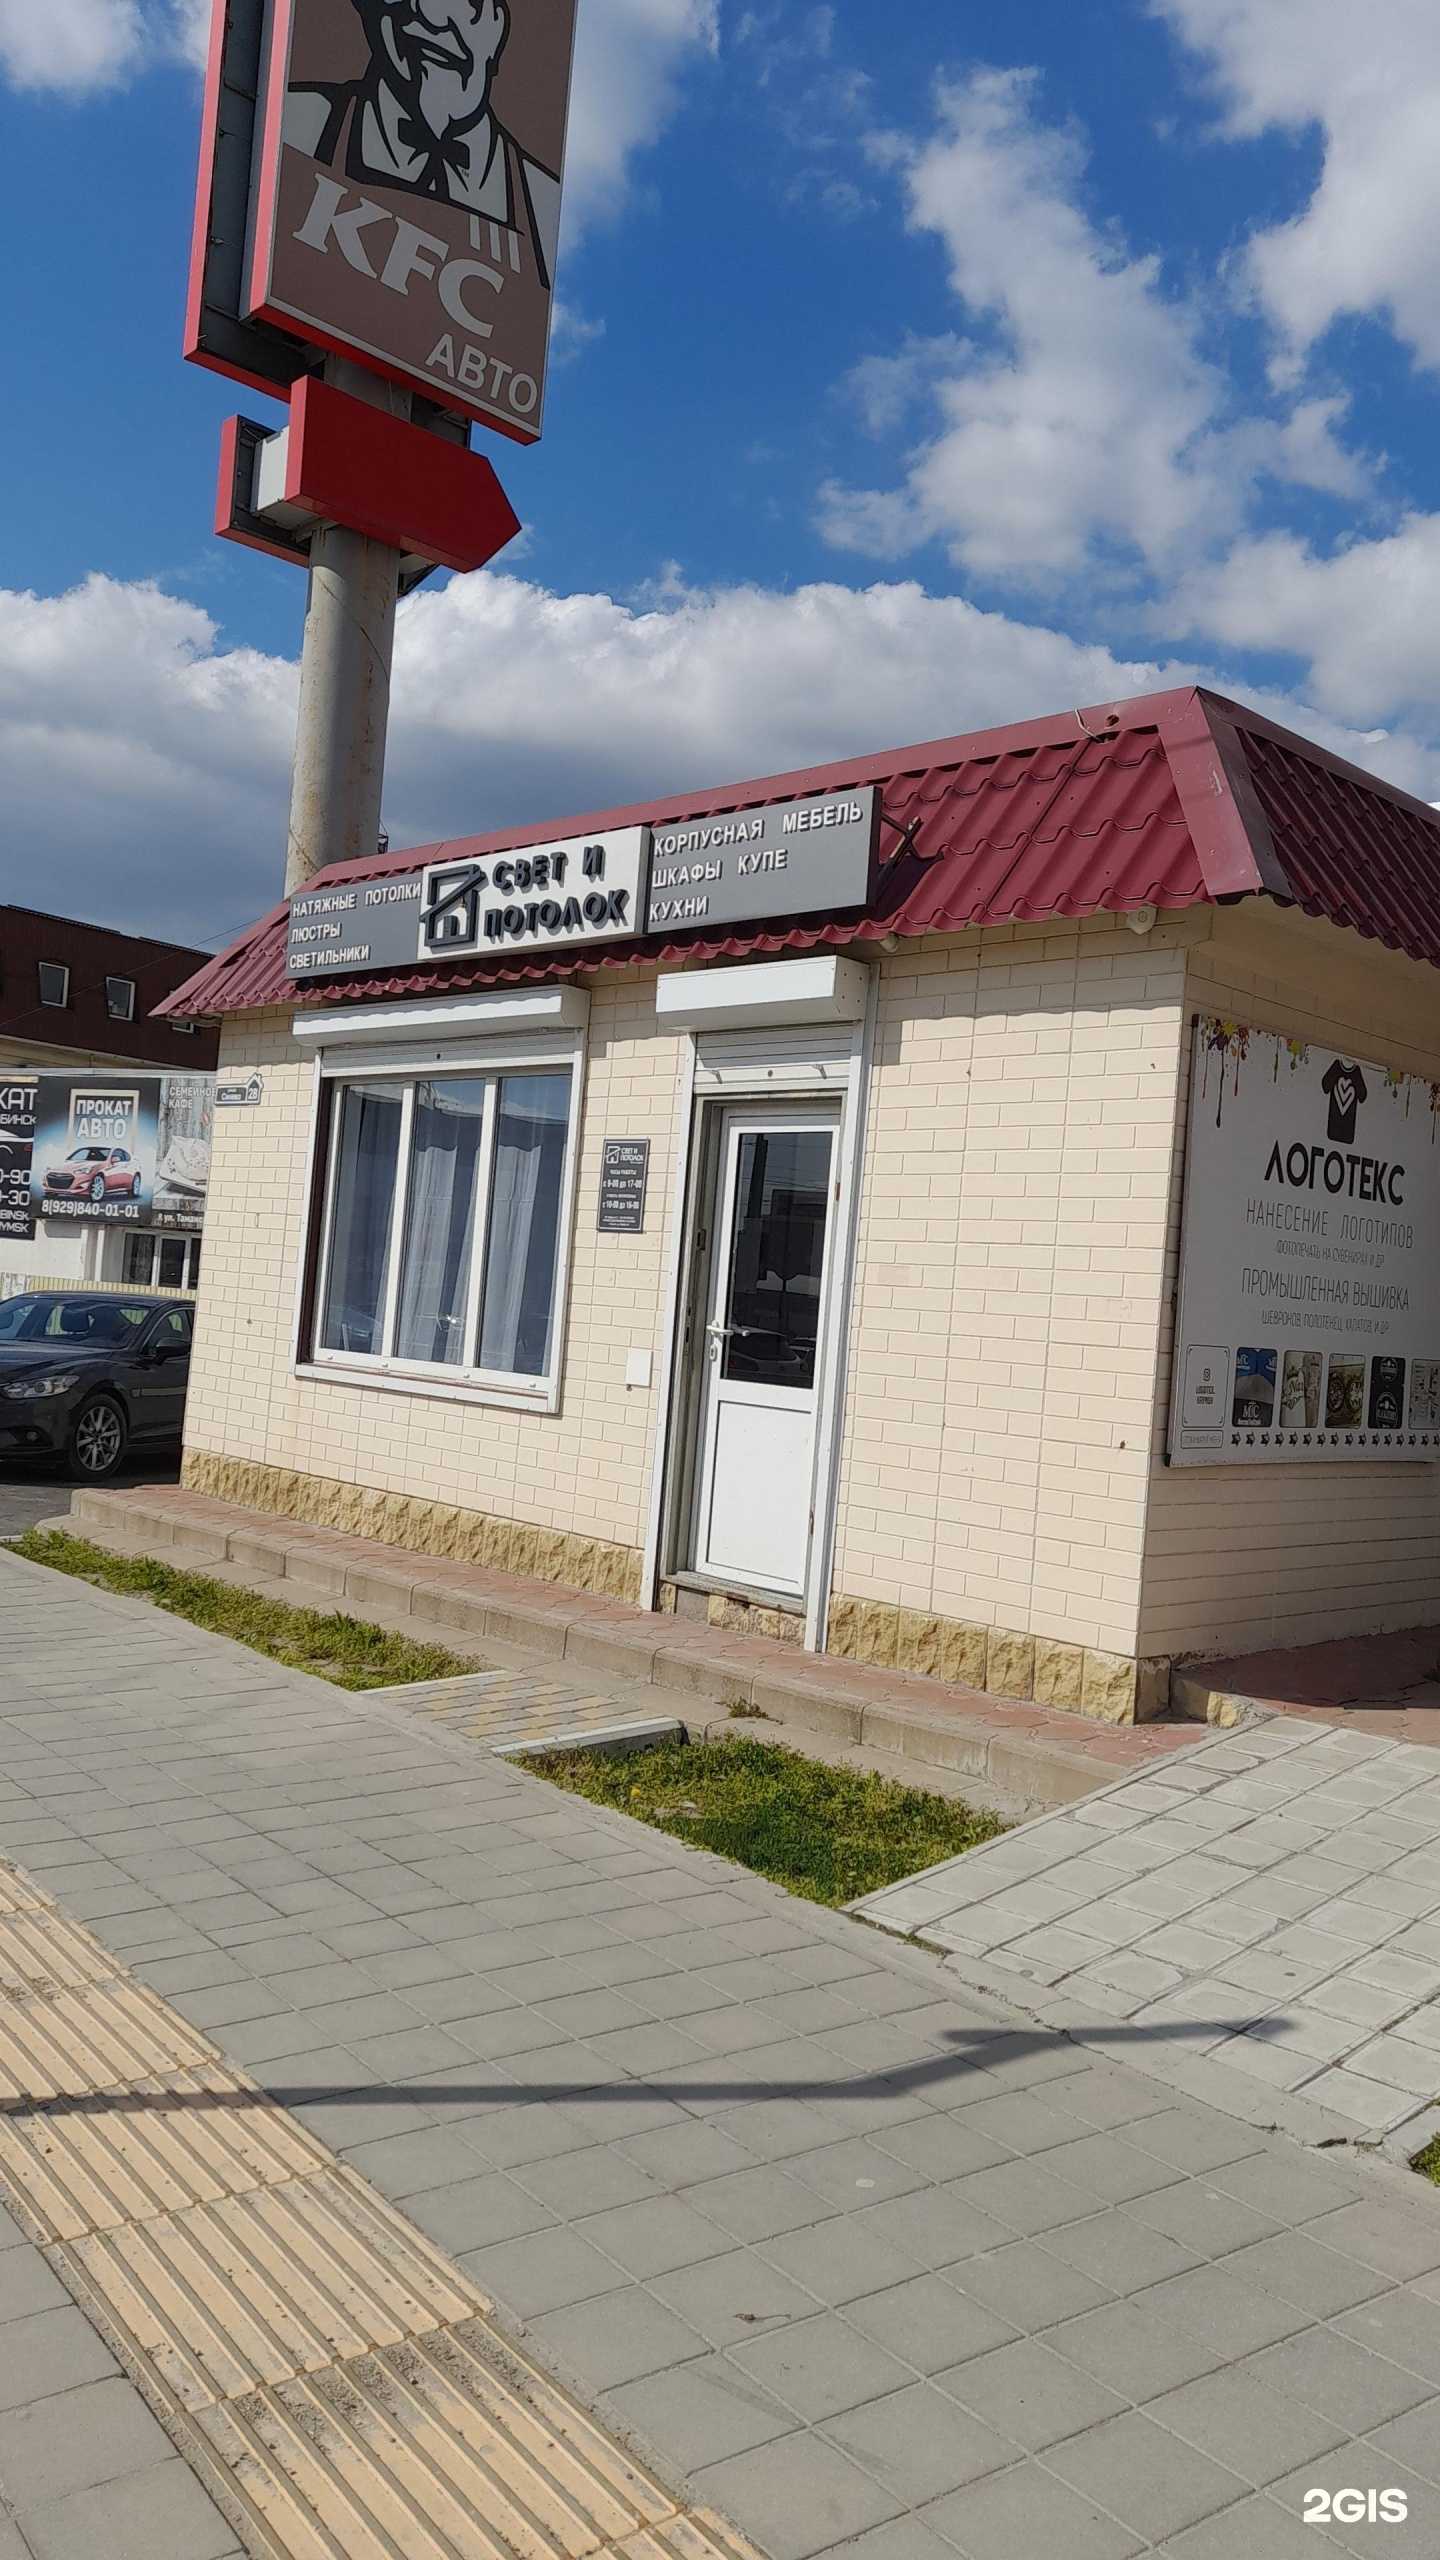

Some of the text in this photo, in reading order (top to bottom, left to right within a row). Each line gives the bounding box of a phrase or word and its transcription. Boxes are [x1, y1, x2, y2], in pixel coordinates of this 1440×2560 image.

[292, 173, 505, 339] KFC
[424, 333, 538, 414] АВТО
[653, 800, 864, 858] КОРПУСНАЯ МЕБЕЛЬ
[492, 844, 606, 896] СВЕТ И
[652, 848, 788, 889] ШКАФЫ КУПЕ
[292, 881, 422, 918] НАТЯЖНЫЕ ПОТОЛКИ
[484, 889, 631, 945] ПОТОЛОК
[648, 895, 710, 922] КУХНИ
[290, 921, 343, 945] ЛЮСТРЫ
[288, 944, 370, 969] СВЕТИЛЬНИКИ
[76, 1099, 132, 1116] ПРОКАТ
[169, 1098, 193, 1109] КАФЕ
[77, 1117, 127, 1139] АВТО
[1264, 1139, 1406, 1206] ЛОГОТЕКС
[41, 1199, 140, 1217] 8(929)840-01-01
[1246, 1198, 1414, 1249] НАНЕСЕНИЕ ЛОГОТИПОВ
[1241, 1267, 1410, 1311] ПРОМЫШЛЕННАЯ ВЫШИВКА
